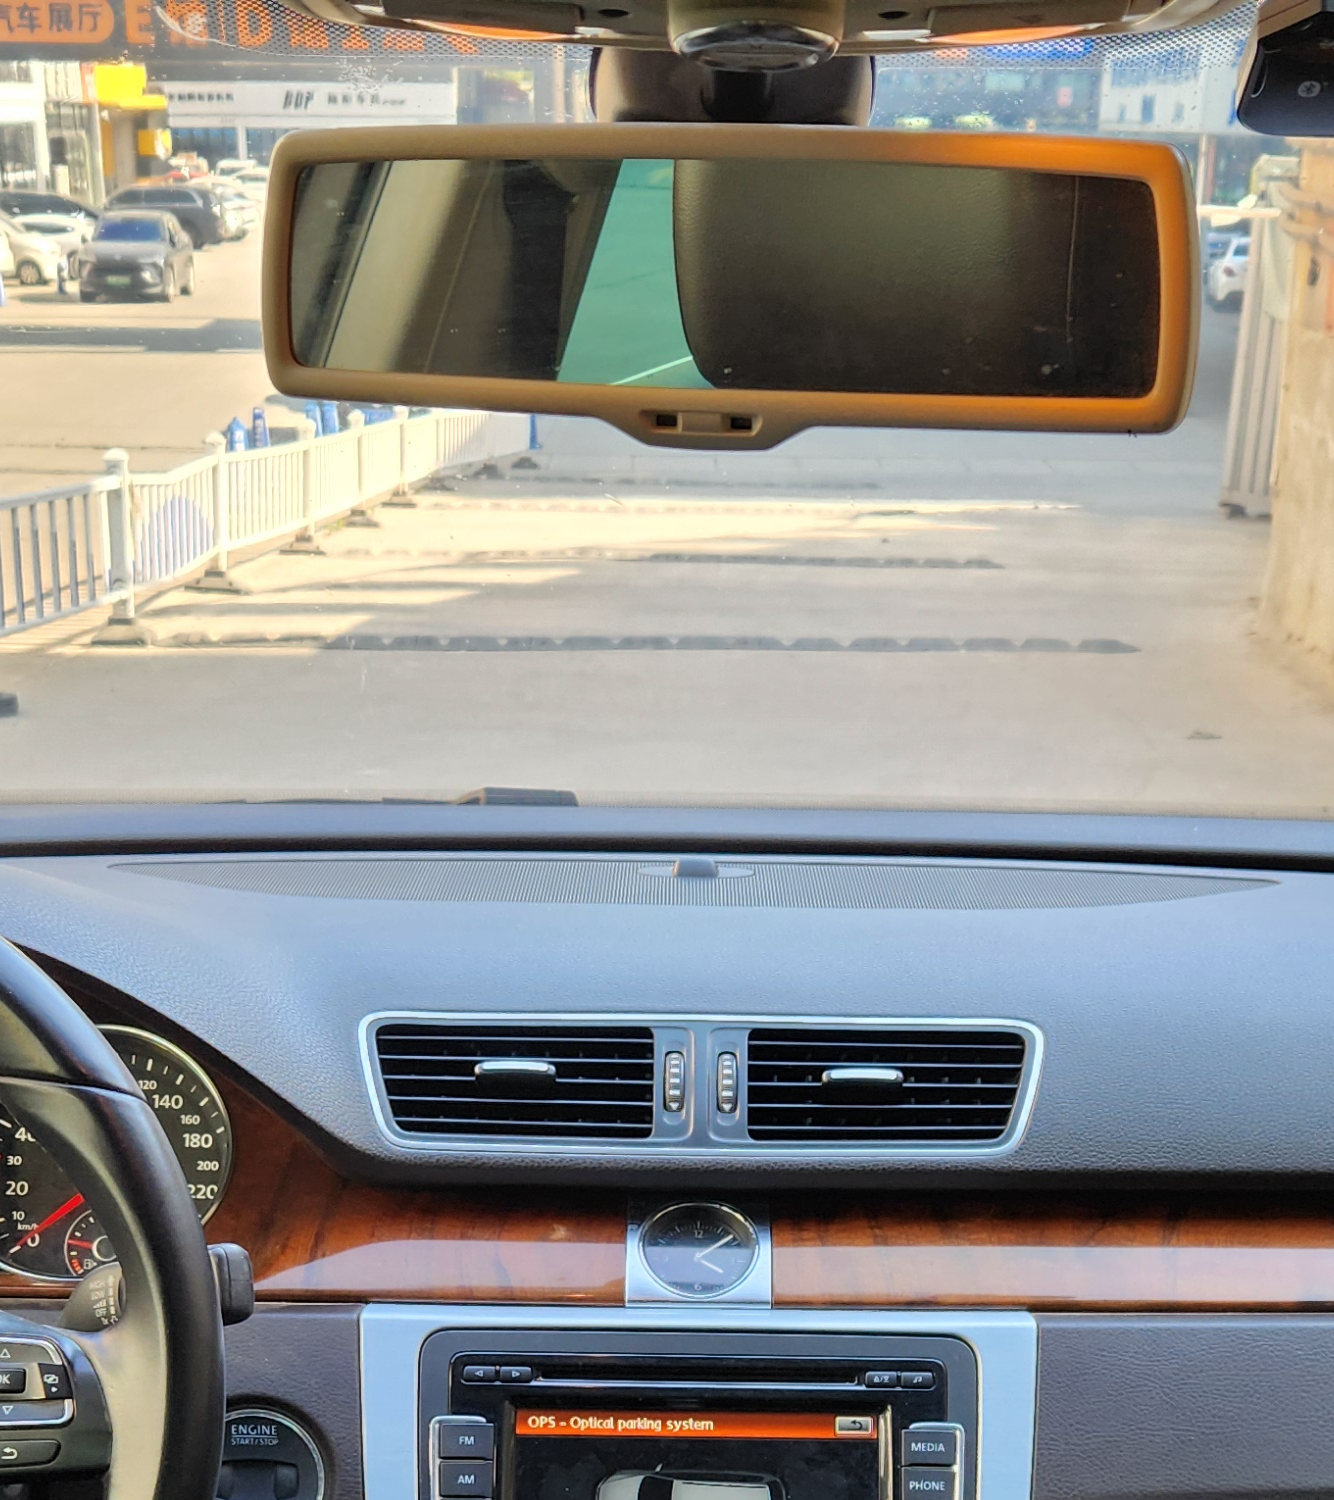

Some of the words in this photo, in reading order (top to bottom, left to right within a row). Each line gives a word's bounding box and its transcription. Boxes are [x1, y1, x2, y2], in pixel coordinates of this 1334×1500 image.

[138, 1080, 157, 1090] 120
[152, 1094, 183, 1109] 140
[180, 1114, 200, 1125] 160
[183, 1133, 213, 1148] 180
[6, 1155, 22, 1166] 30
[196, 1161, 219, 1171] 200
[5, 1181, 29, 1196] 20
[187, 1184, 218, 1199] 220
[11, 1211, 25, 1221] 10
[27, 1233, 40, 1247] 0
[694, 1230, 703, 1239] 12
[694, 1283, 702, 1291] 6
[527, 1416, 556, 1429] OPS
[569, 1416, 615, 1431] Optical
[617, 1417, 662, 1432] parking
[666, 1419, 714, 1432] system
[231, 1424, 278, 1436] ENGINE
[458, 1436, 475, 1446] FM
[910, 1442, 945, 1452] MEDIA
[457, 1474, 475, 1484] AM
[909, 1480, 945, 1491] PHONE
